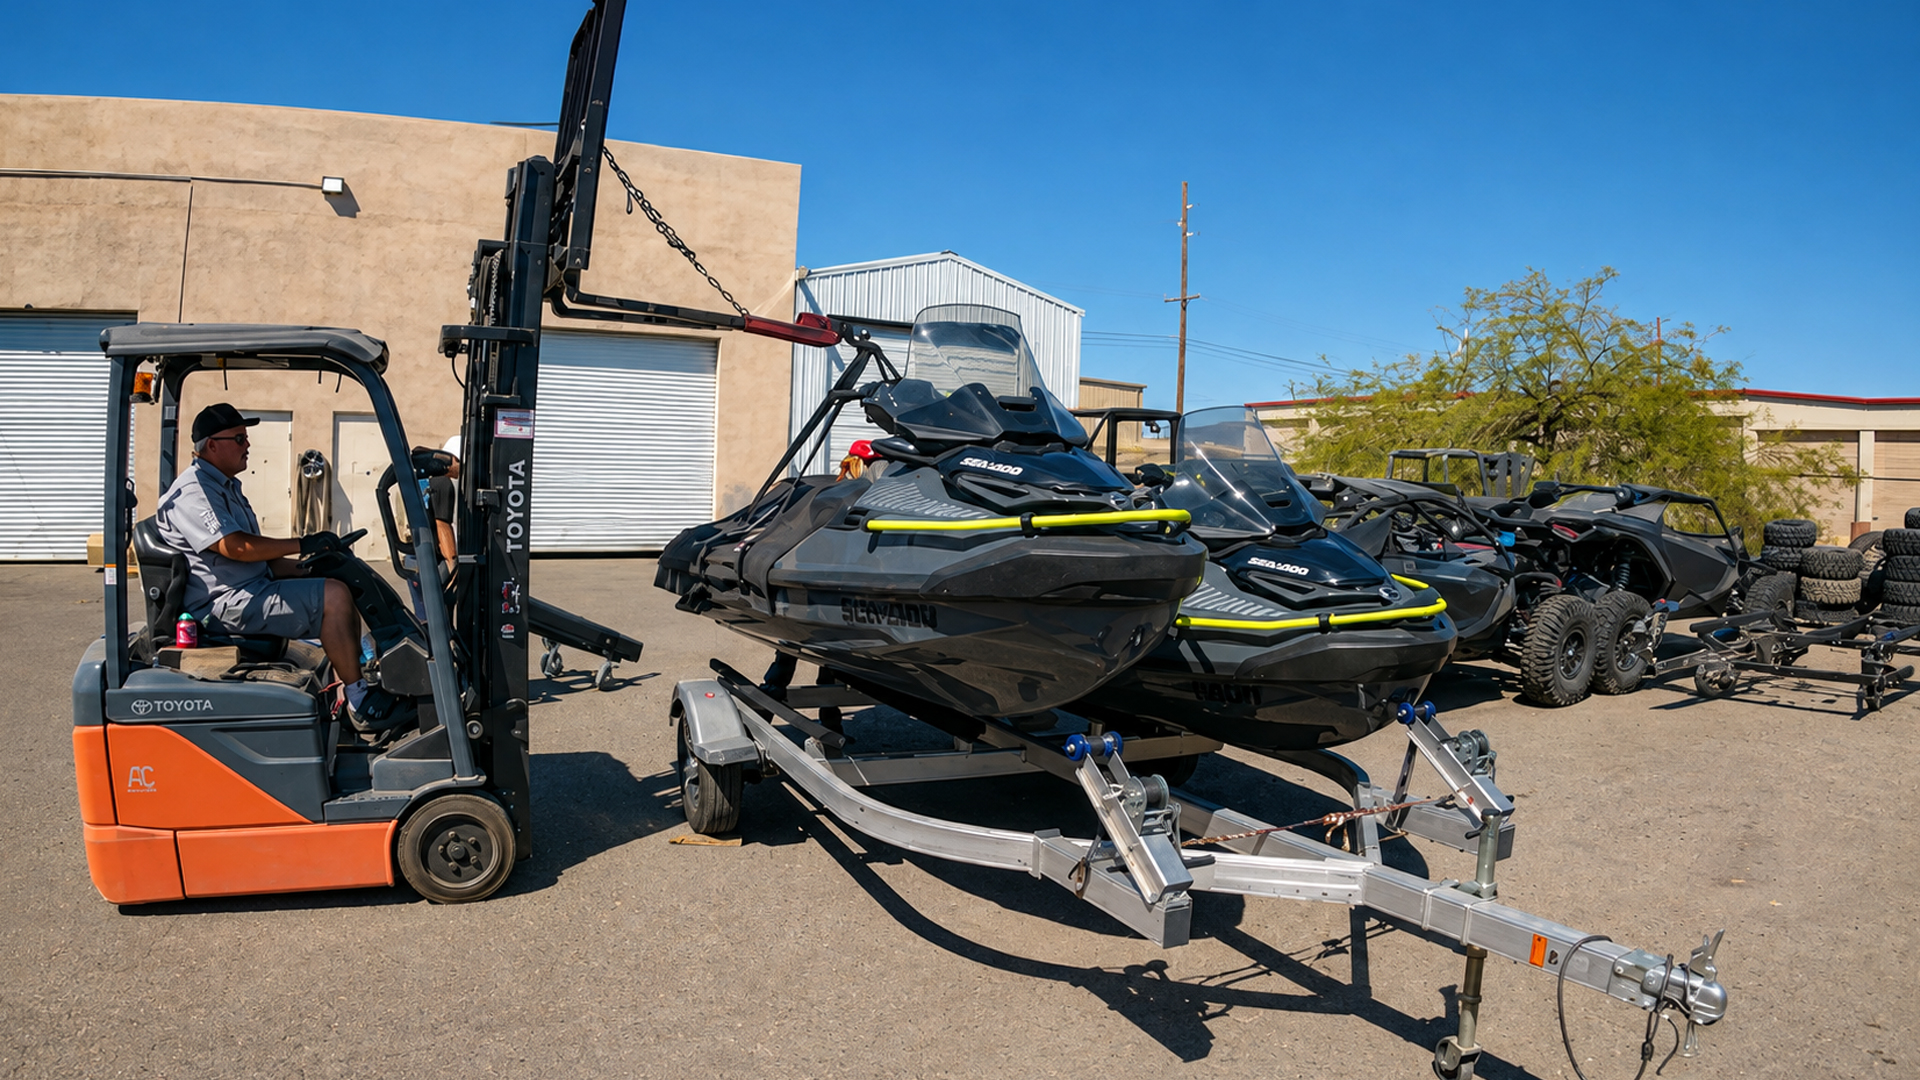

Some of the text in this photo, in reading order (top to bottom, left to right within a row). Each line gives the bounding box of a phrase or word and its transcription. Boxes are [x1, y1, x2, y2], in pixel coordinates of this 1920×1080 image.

[506, 459, 526, 553] TOYOTA
[154, 699, 214, 712] TOYOTA
[128, 766, 155, 788] AC
